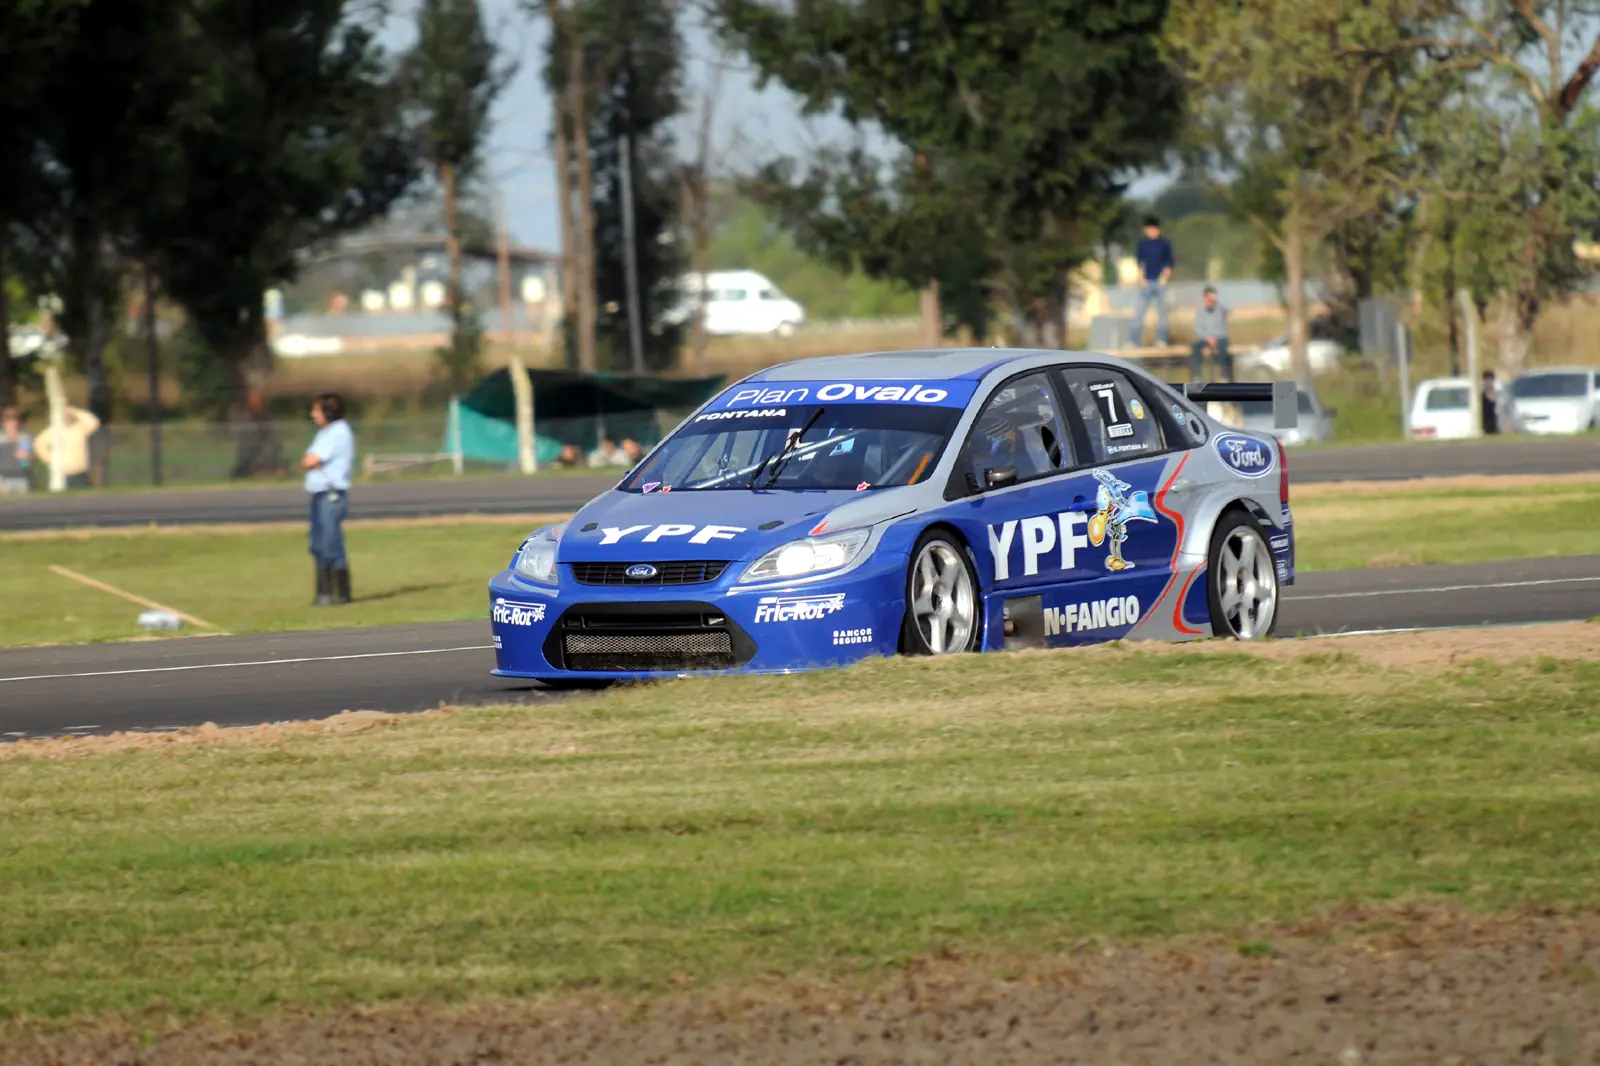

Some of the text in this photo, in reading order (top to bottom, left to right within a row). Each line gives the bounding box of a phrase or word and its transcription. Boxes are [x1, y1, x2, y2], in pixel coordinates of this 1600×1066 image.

[727, 383, 948, 408] Plan Ovalo
[1097, 389, 1118, 423] 7
[695, 409, 787, 422] FONTANA
[1225, 439, 1266, 468] Ford
[598, 524, 748, 545] YPF
[987, 511, 1088, 580] YPF
[494, 605, 532, 626] Fric-Rot
[754, 602, 825, 623] Fric-Rot
[833, 628, 873, 638] BANCOR
[833, 636, 873, 645] SEGUROS
